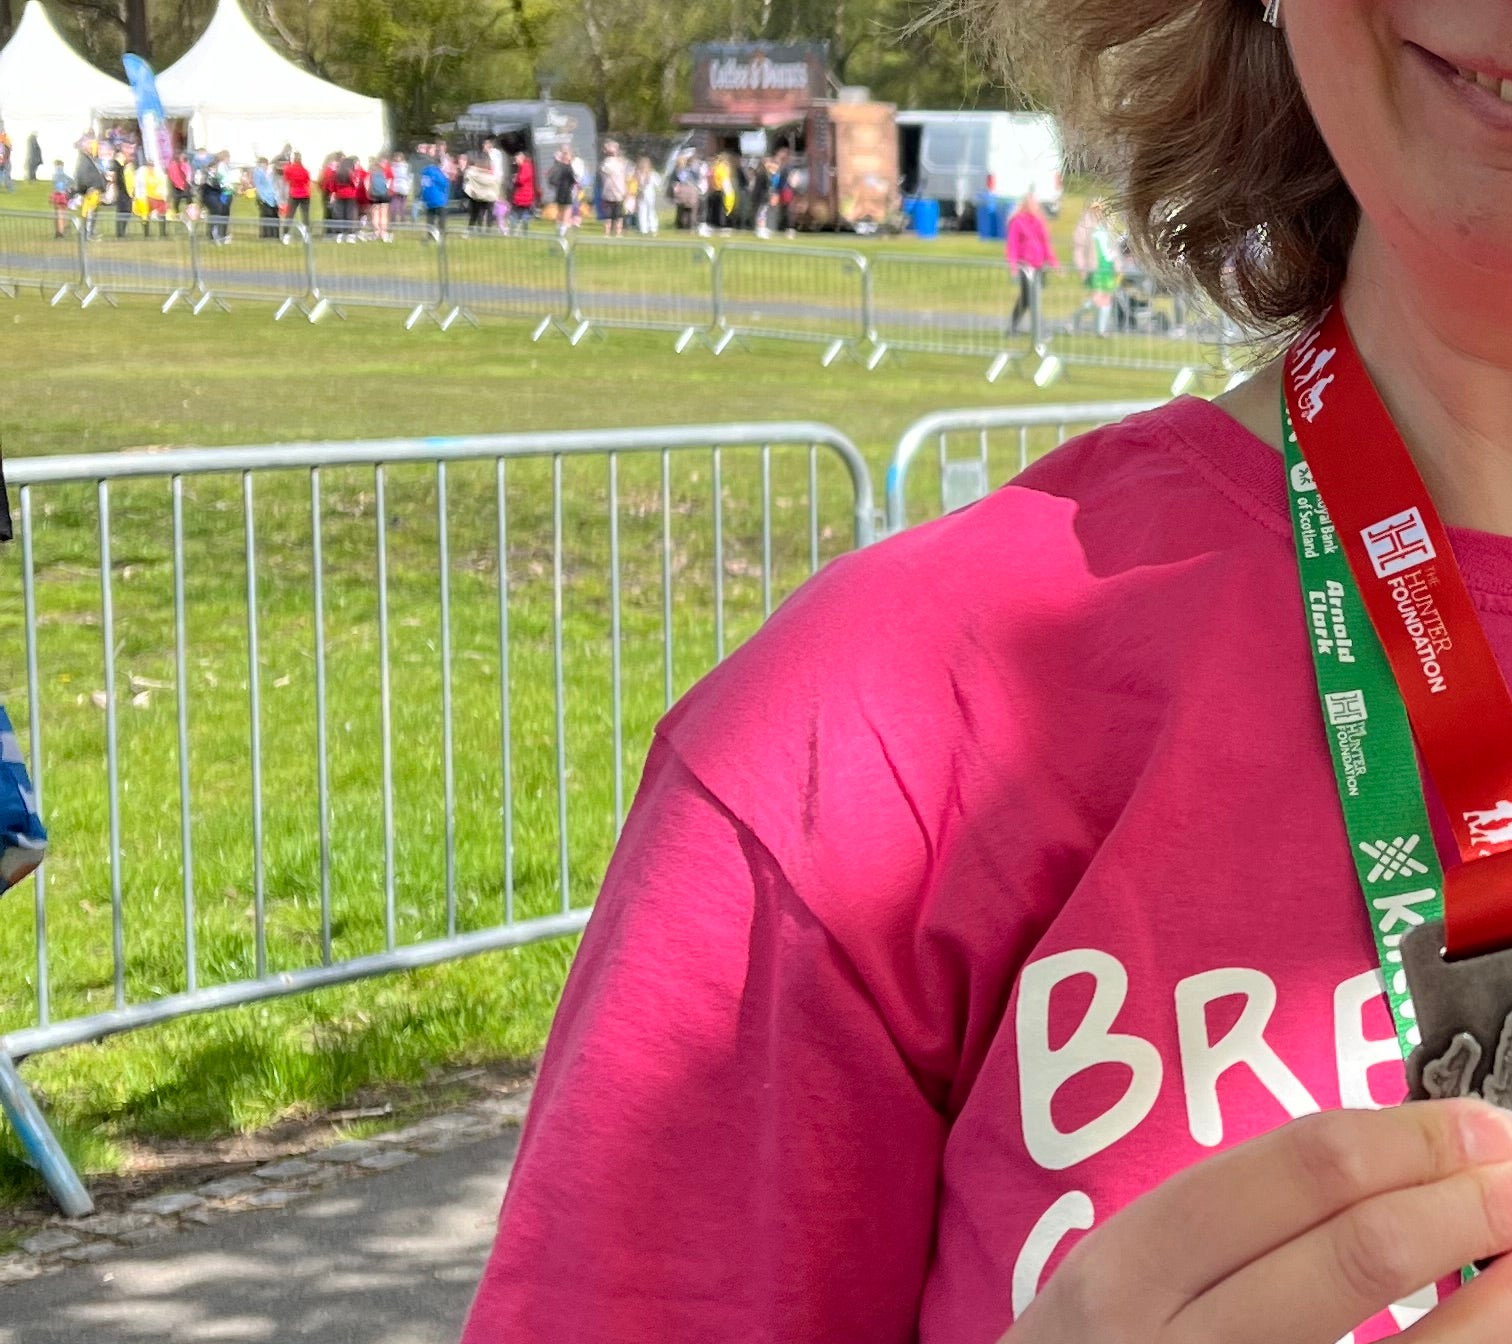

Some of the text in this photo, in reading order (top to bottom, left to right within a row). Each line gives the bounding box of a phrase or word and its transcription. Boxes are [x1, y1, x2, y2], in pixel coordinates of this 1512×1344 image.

[1297, 497, 1320, 559] of Scotland
[1425, 565, 1441, 587] THE
[1308, 590, 1334, 655] Clark
[1326, 579, 1356, 663] Arnold
[1387, 576, 1447, 694] FOUNDATION
[1404, 569, 1453, 653] HUNTER
[1335, 725, 1360, 797] FOUNDATION
[1345, 723, 1367, 776] HUNTER
